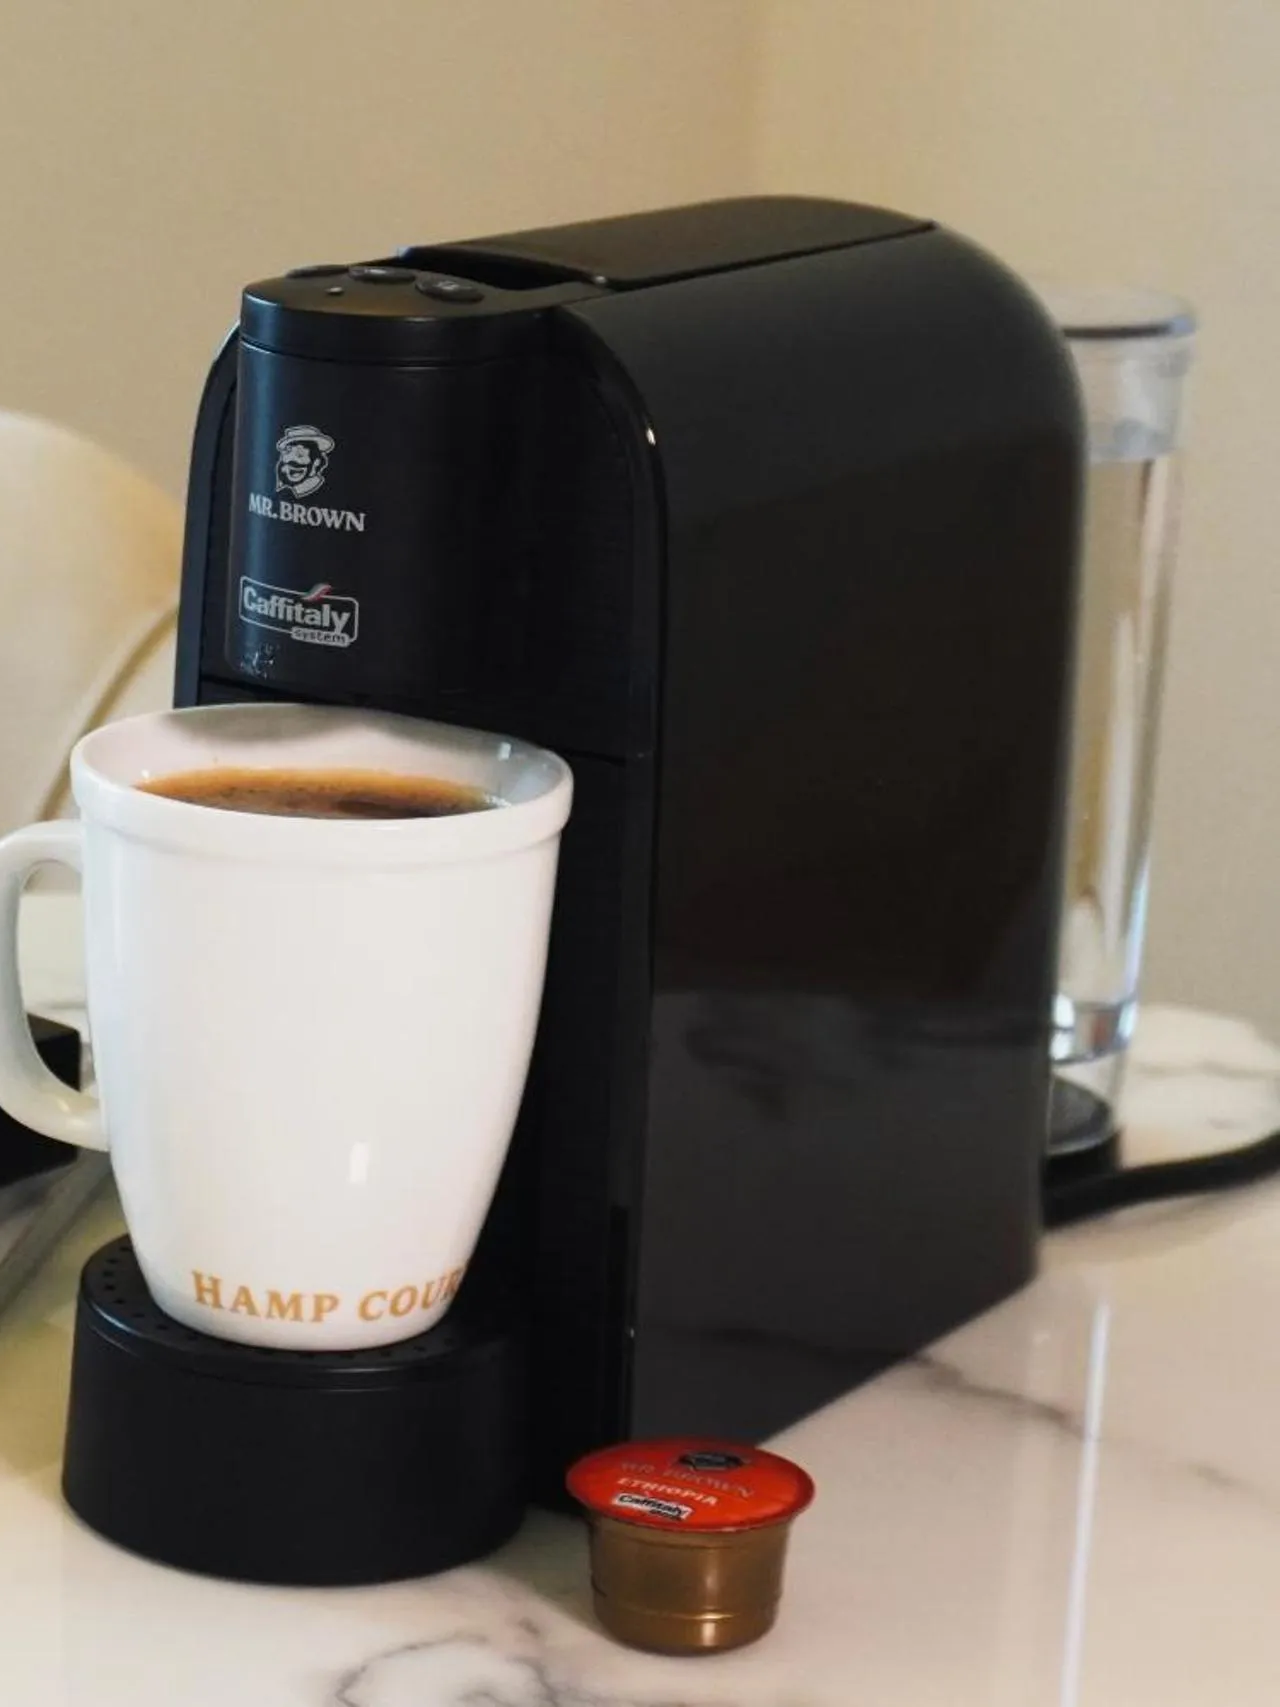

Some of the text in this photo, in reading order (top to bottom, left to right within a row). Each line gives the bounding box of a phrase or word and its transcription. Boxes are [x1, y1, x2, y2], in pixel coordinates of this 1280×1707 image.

[279, 500, 366, 532] BROWN
[243, 586, 351, 634] Caffitaly
[192, 1270, 341, 1323] HAMP
[617, 1477, 719, 1507] ETHIOPIA
